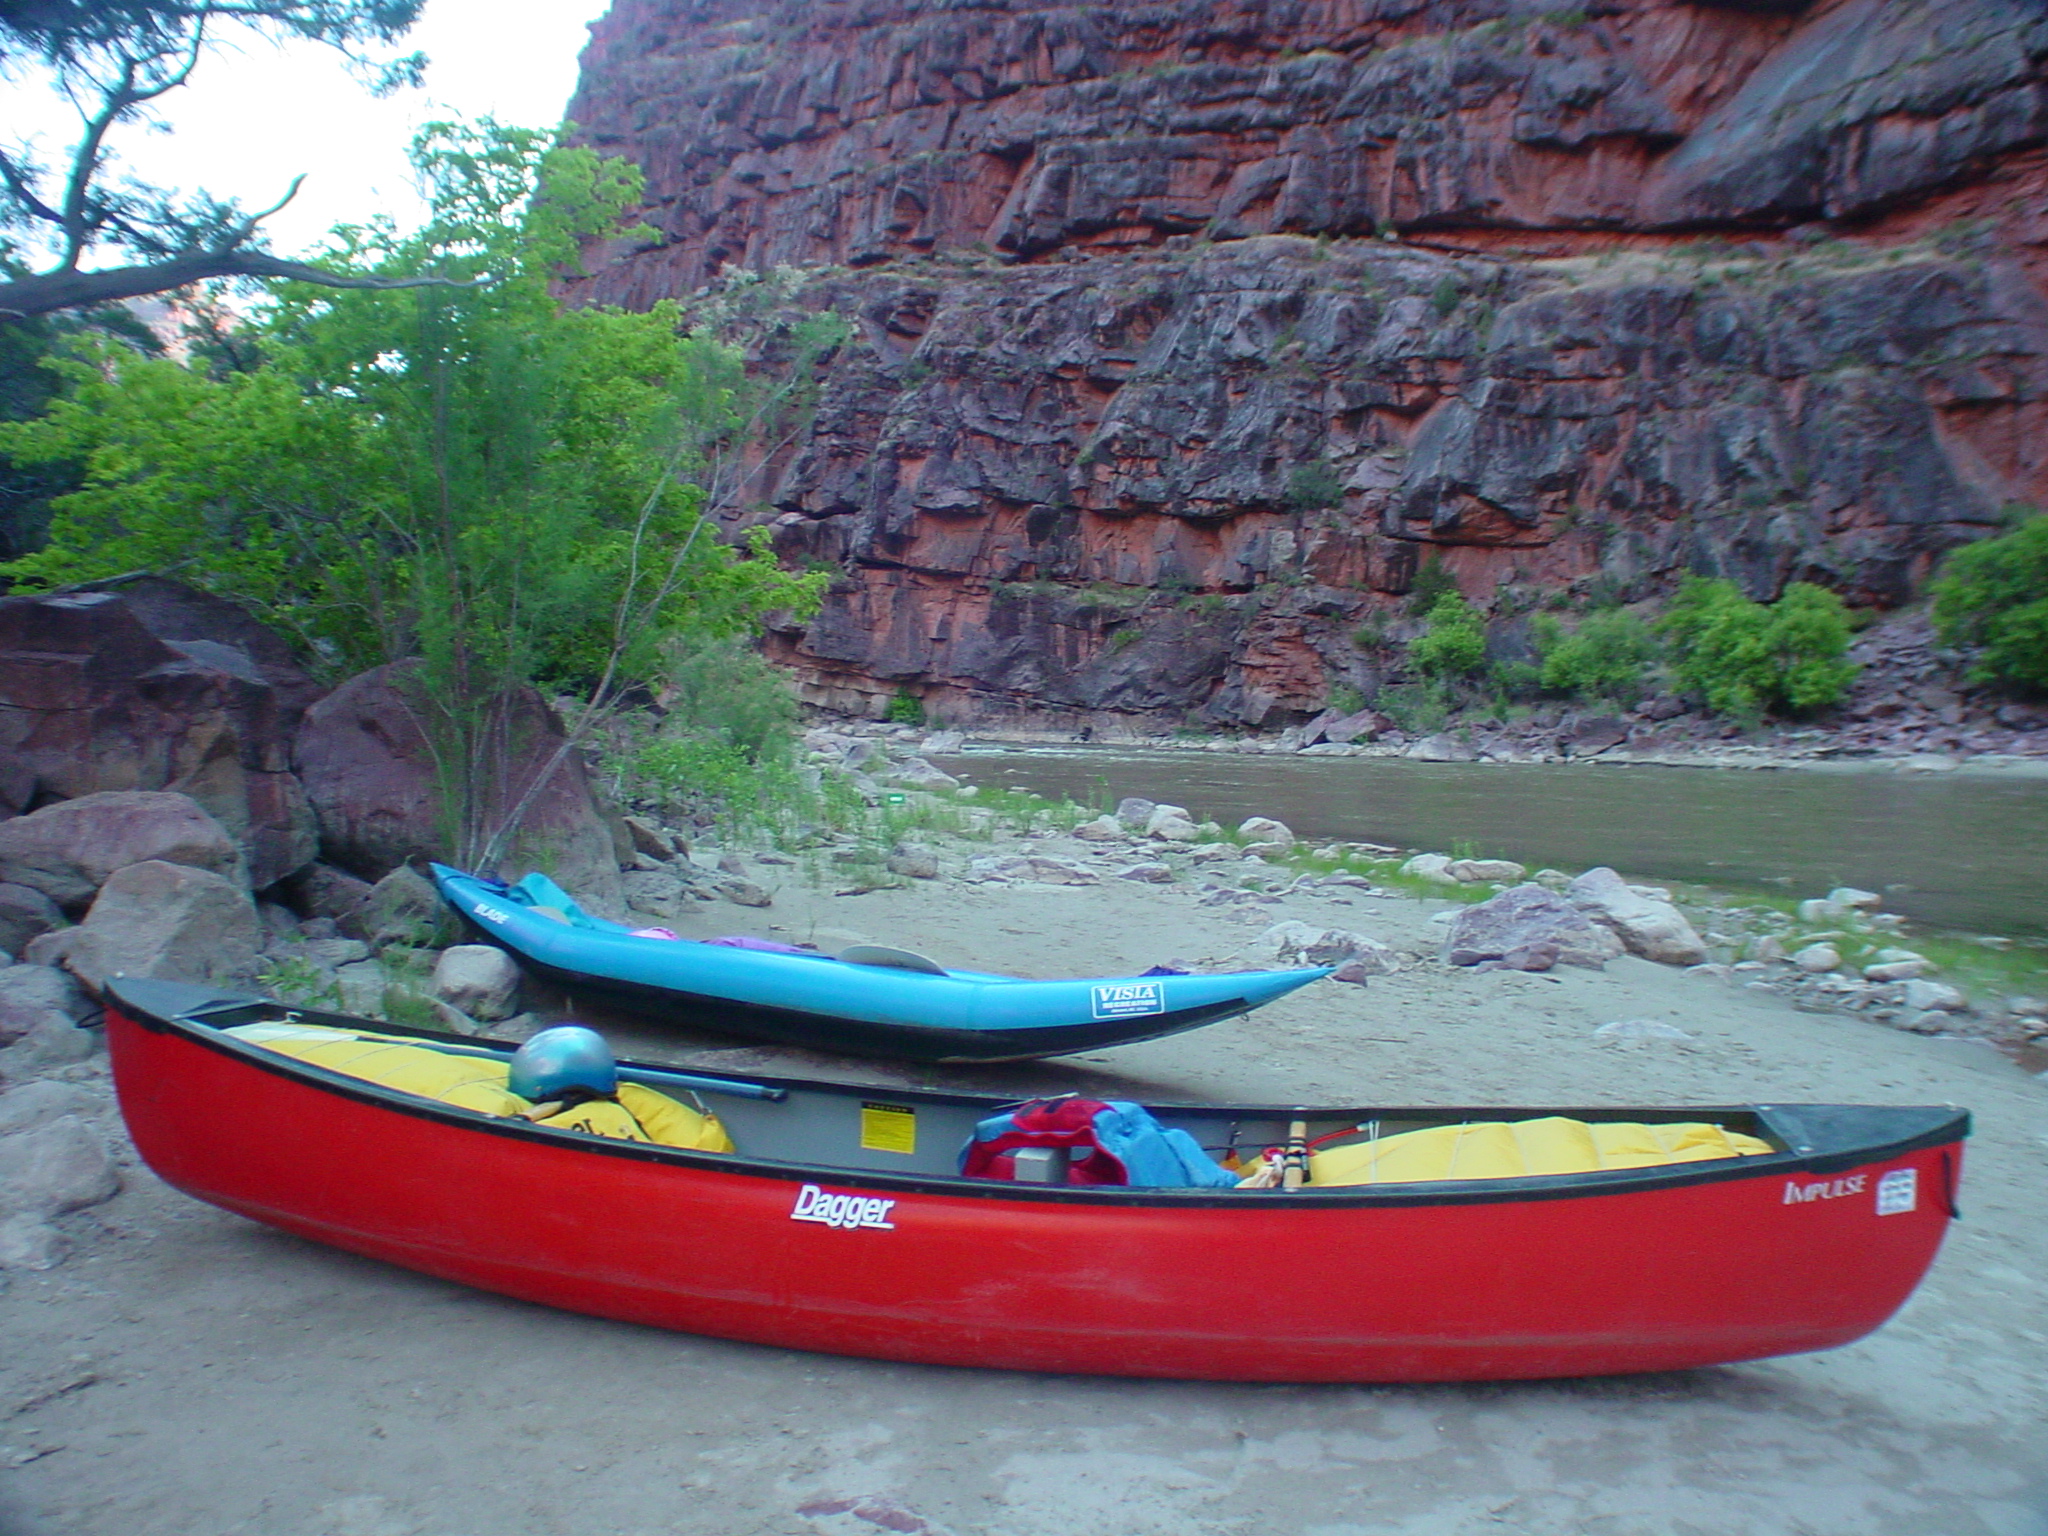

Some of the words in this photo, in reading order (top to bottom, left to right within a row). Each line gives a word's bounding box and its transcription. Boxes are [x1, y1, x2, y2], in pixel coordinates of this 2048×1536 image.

[474, 903, 509, 924] BLADE
[1098, 984, 1156, 1002] VISIA
[1783, 1175, 1868, 1205] IMPULSE
[793, 1184, 896, 1229] Dagger
